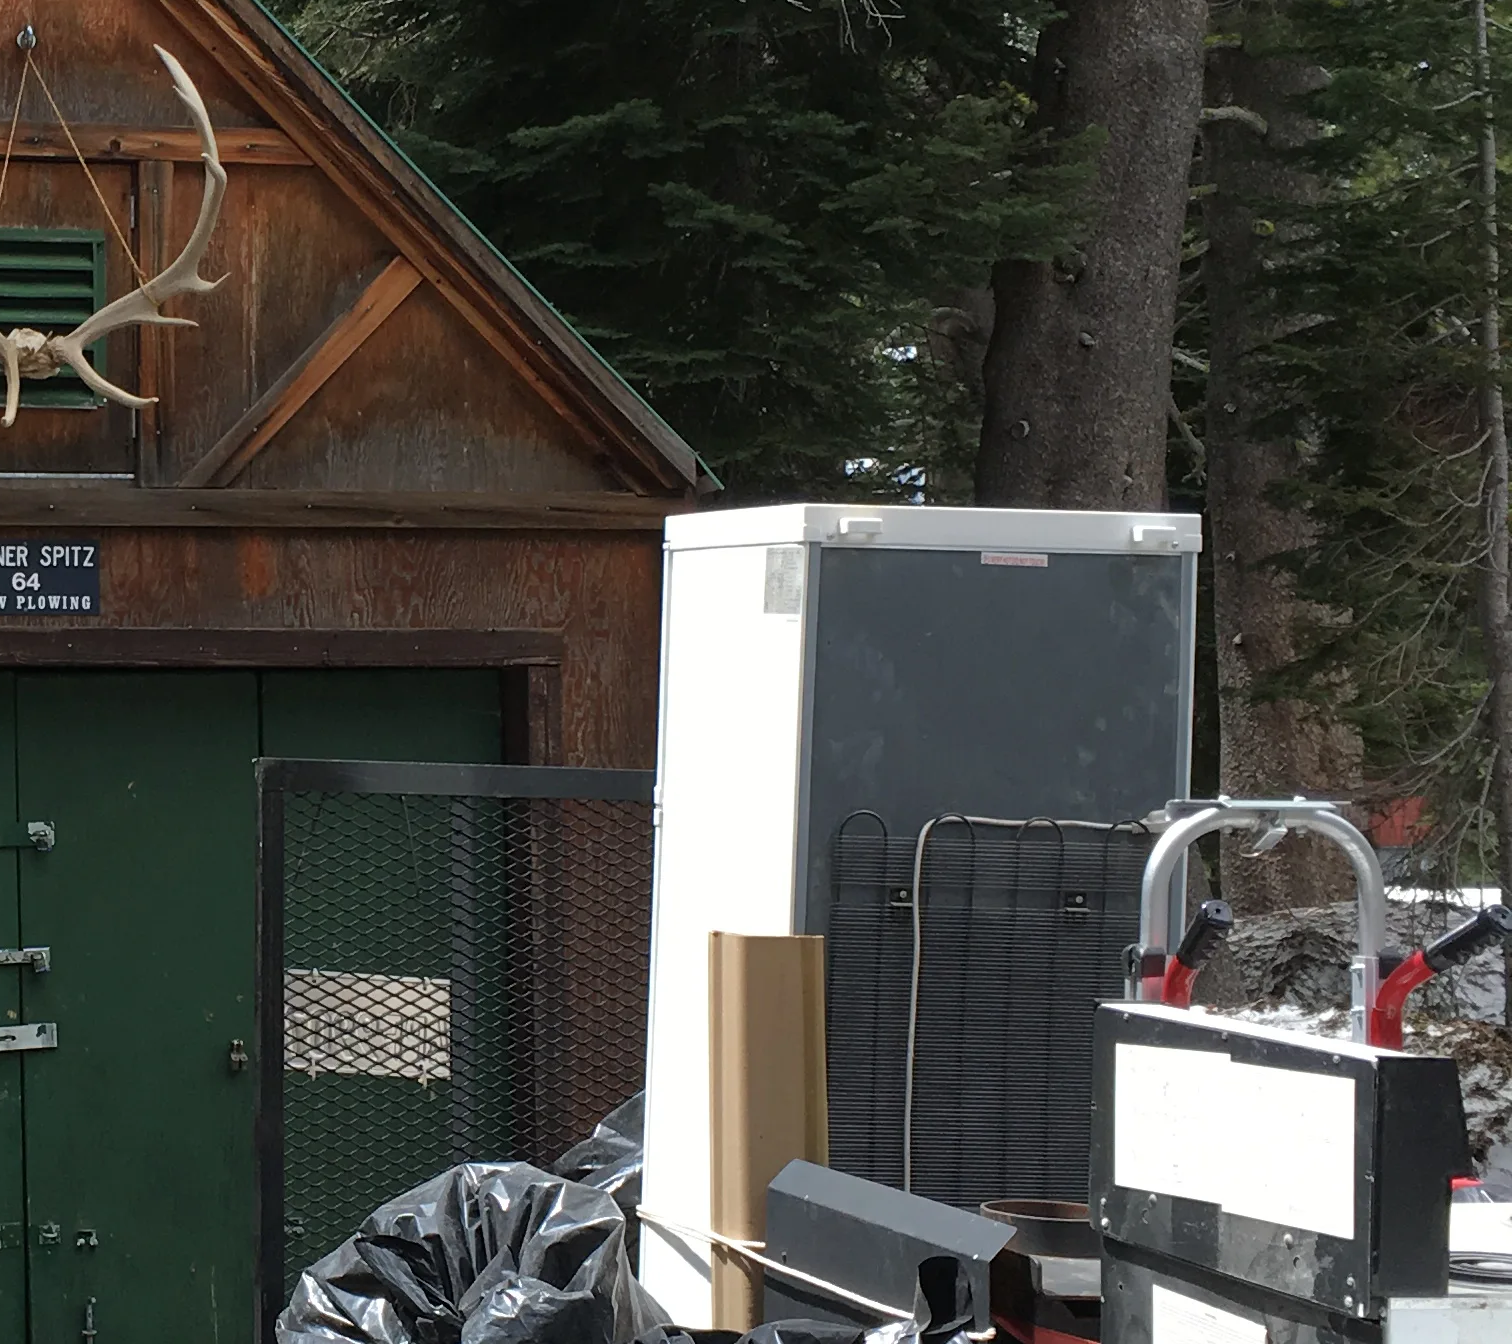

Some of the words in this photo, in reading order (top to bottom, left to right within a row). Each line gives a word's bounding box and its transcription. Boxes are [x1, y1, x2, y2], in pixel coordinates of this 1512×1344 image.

[40, 546, 94, 567] SPITZ
[12, 572, 40, 591] 64
[16, 595, 91, 610] PLOWING
